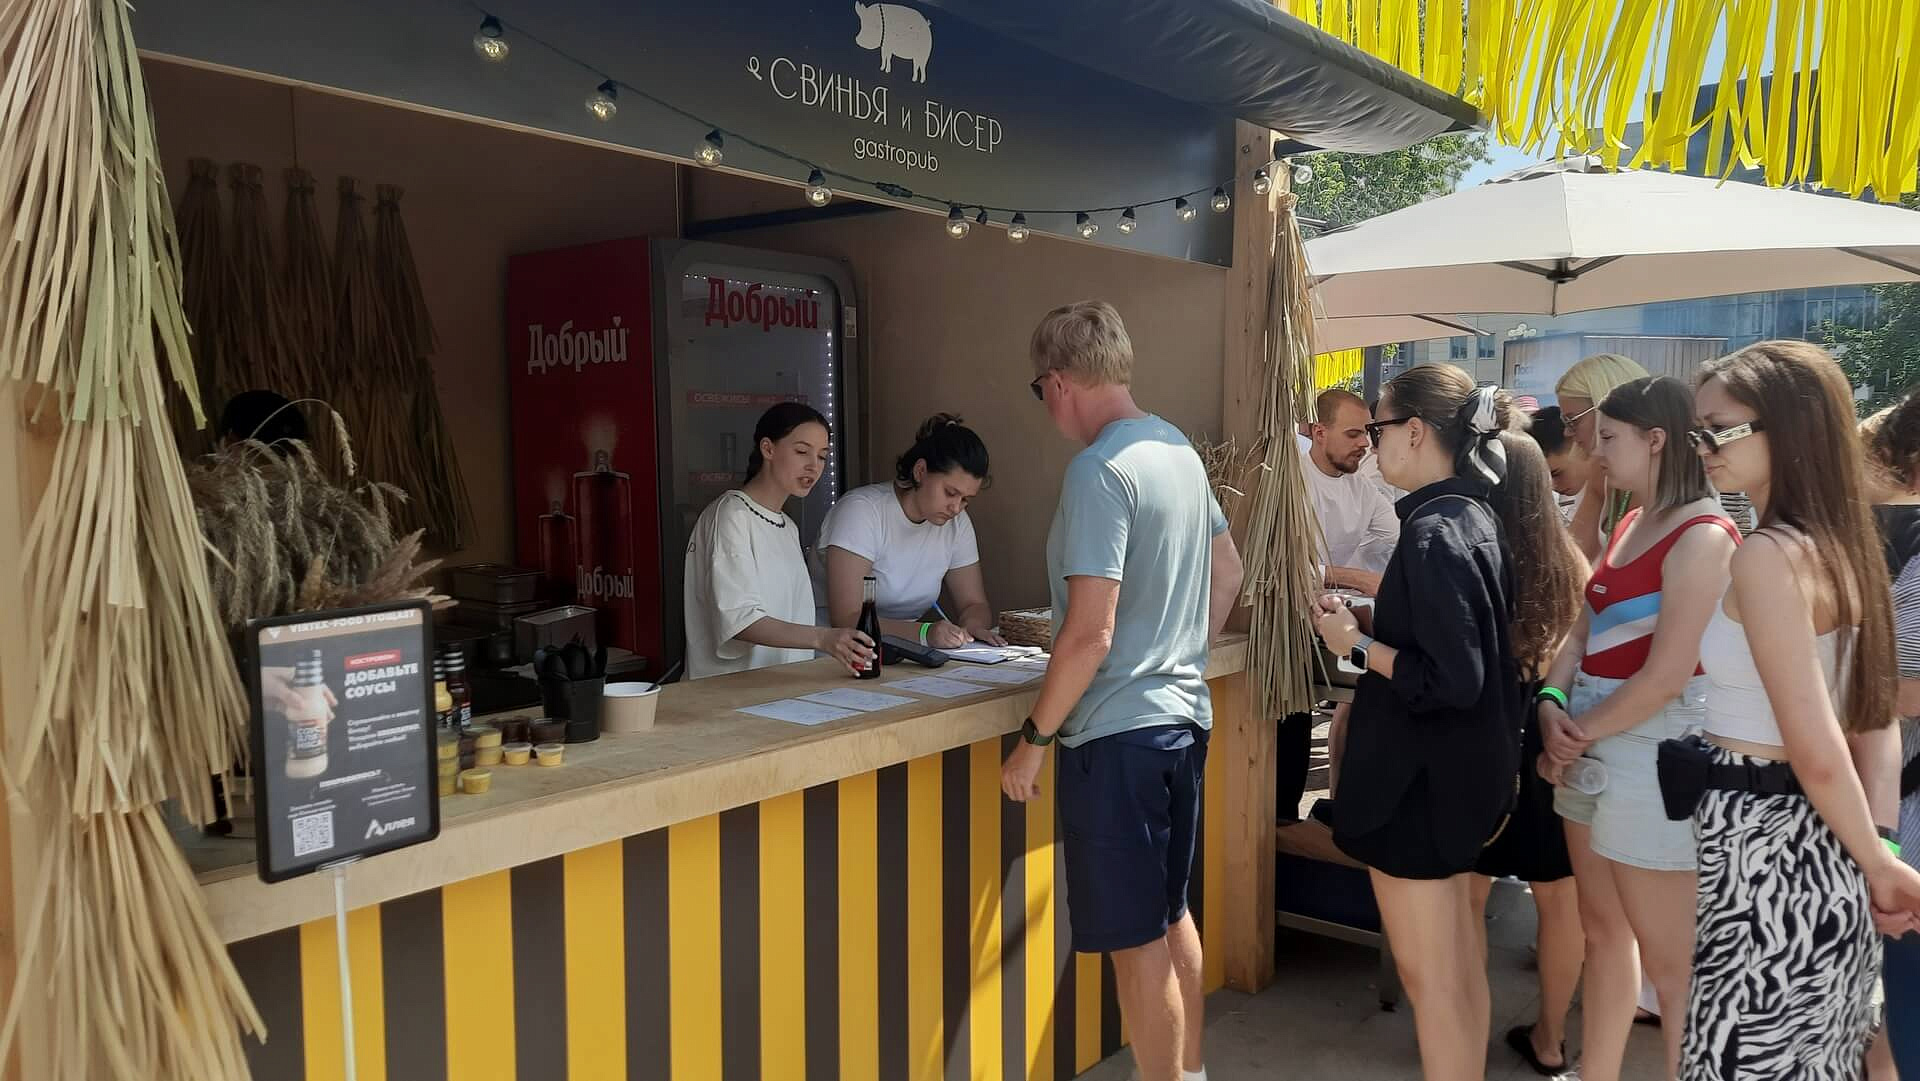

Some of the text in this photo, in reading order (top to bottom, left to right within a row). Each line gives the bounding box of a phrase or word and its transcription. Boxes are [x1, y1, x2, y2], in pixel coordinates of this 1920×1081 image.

[770, 57, 1002, 153] СВИНЬЯ и БИСЕР
[854, 137, 938, 172] gastropub
[705, 276, 817, 332] Добрый
[528, 315, 627, 375] Добрый
[576, 563, 634, 602] Добрый
[344, 662, 418, 687] ДОБАВЬТЕ
[345, 680, 397, 699] СОУСЫ
